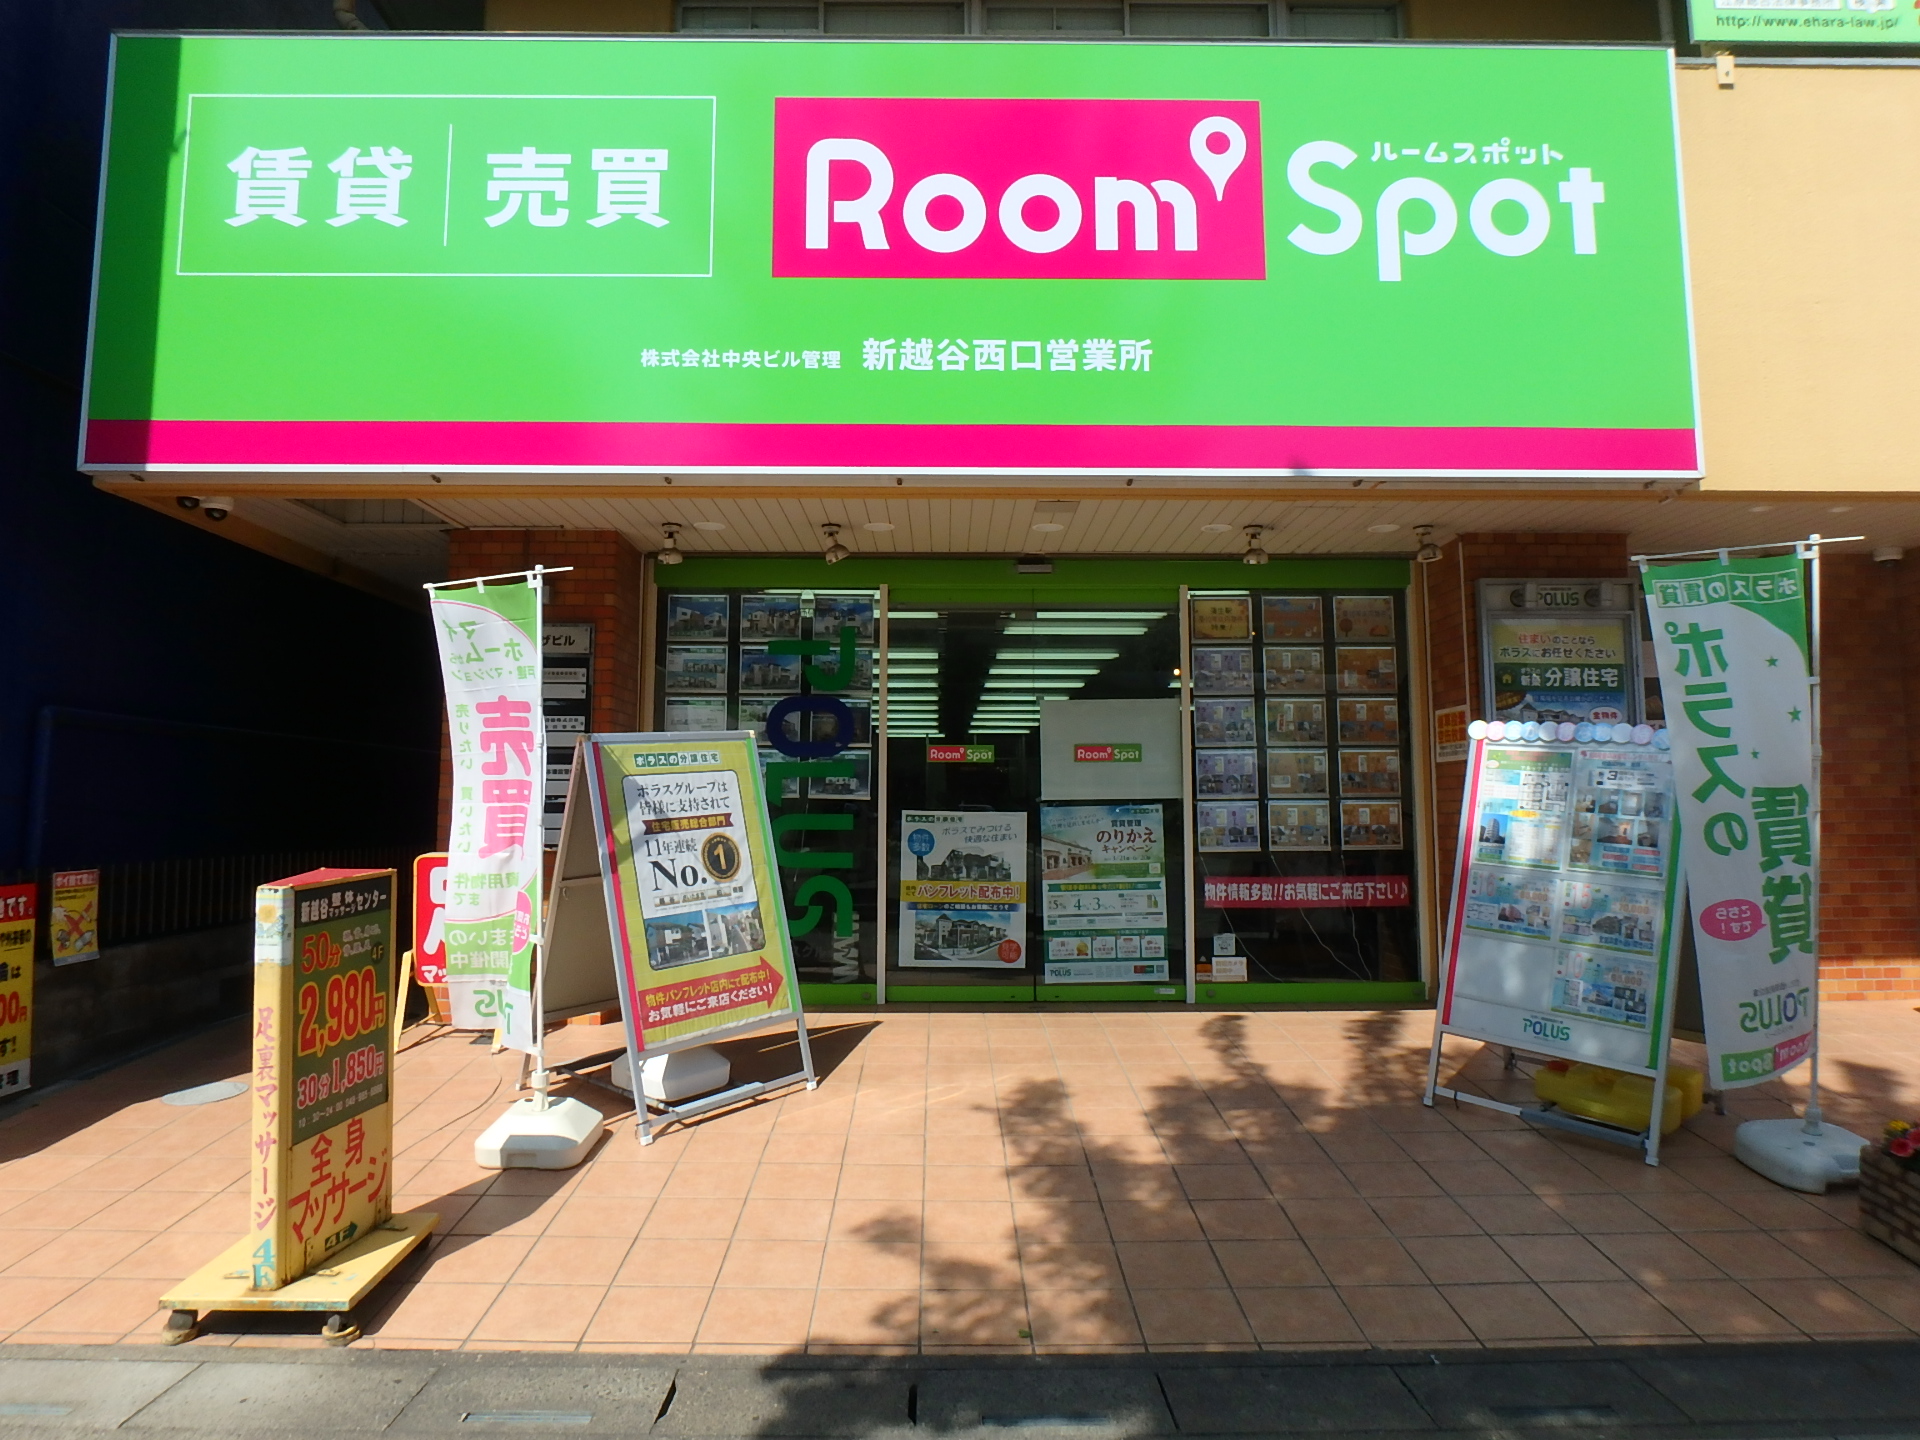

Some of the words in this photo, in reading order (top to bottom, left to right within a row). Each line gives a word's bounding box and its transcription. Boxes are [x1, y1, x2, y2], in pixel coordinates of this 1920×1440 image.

[1370, 138, 1564, 166] ルームスポット
[224, 146, 413, 228] 賃貸
[483, 146, 670, 228] 売買
[1286, 140, 1605, 282] Spot
[640, 348, 841, 368] 株式会社中央ビル管理
[862, 337, 1154, 371] 新越谷西口営業所
[1545, 667, 1619, 688] 分譲住宅
[637, 781, 728, 798] ポラスグループは
[765, 626, 856, 938] POLUS
[640, 796, 730, 815] 皆様に支持されて
[651, 815, 726, 833] 住宅販売総合部門
[1096, 827, 1157, 844] のりかえ
[644, 838, 698, 858] 11年連続
[1102, 845, 1153, 854] キャンペーン
[649, 858, 708, 892] No.
[917, 884, 1021, 900] パンフレット配布中!
[301, 931, 342, 974] 50分
[298, 964, 387, 1058] 2,980円
[648, 983, 773, 1022] お気軽にご来店ください!
[1522, 1018, 1571, 1042] POLUS
[297, 1073, 332, 1110] 30分
[332, 1043, 385, 1094] 1,850円
[252, 1006, 278, 1231] 足裏マッサージ
[310, 1116, 366, 1189] 全身
[288, 1148, 388, 1245] マッサージ
[326, 1228, 350, 1252] 4F
